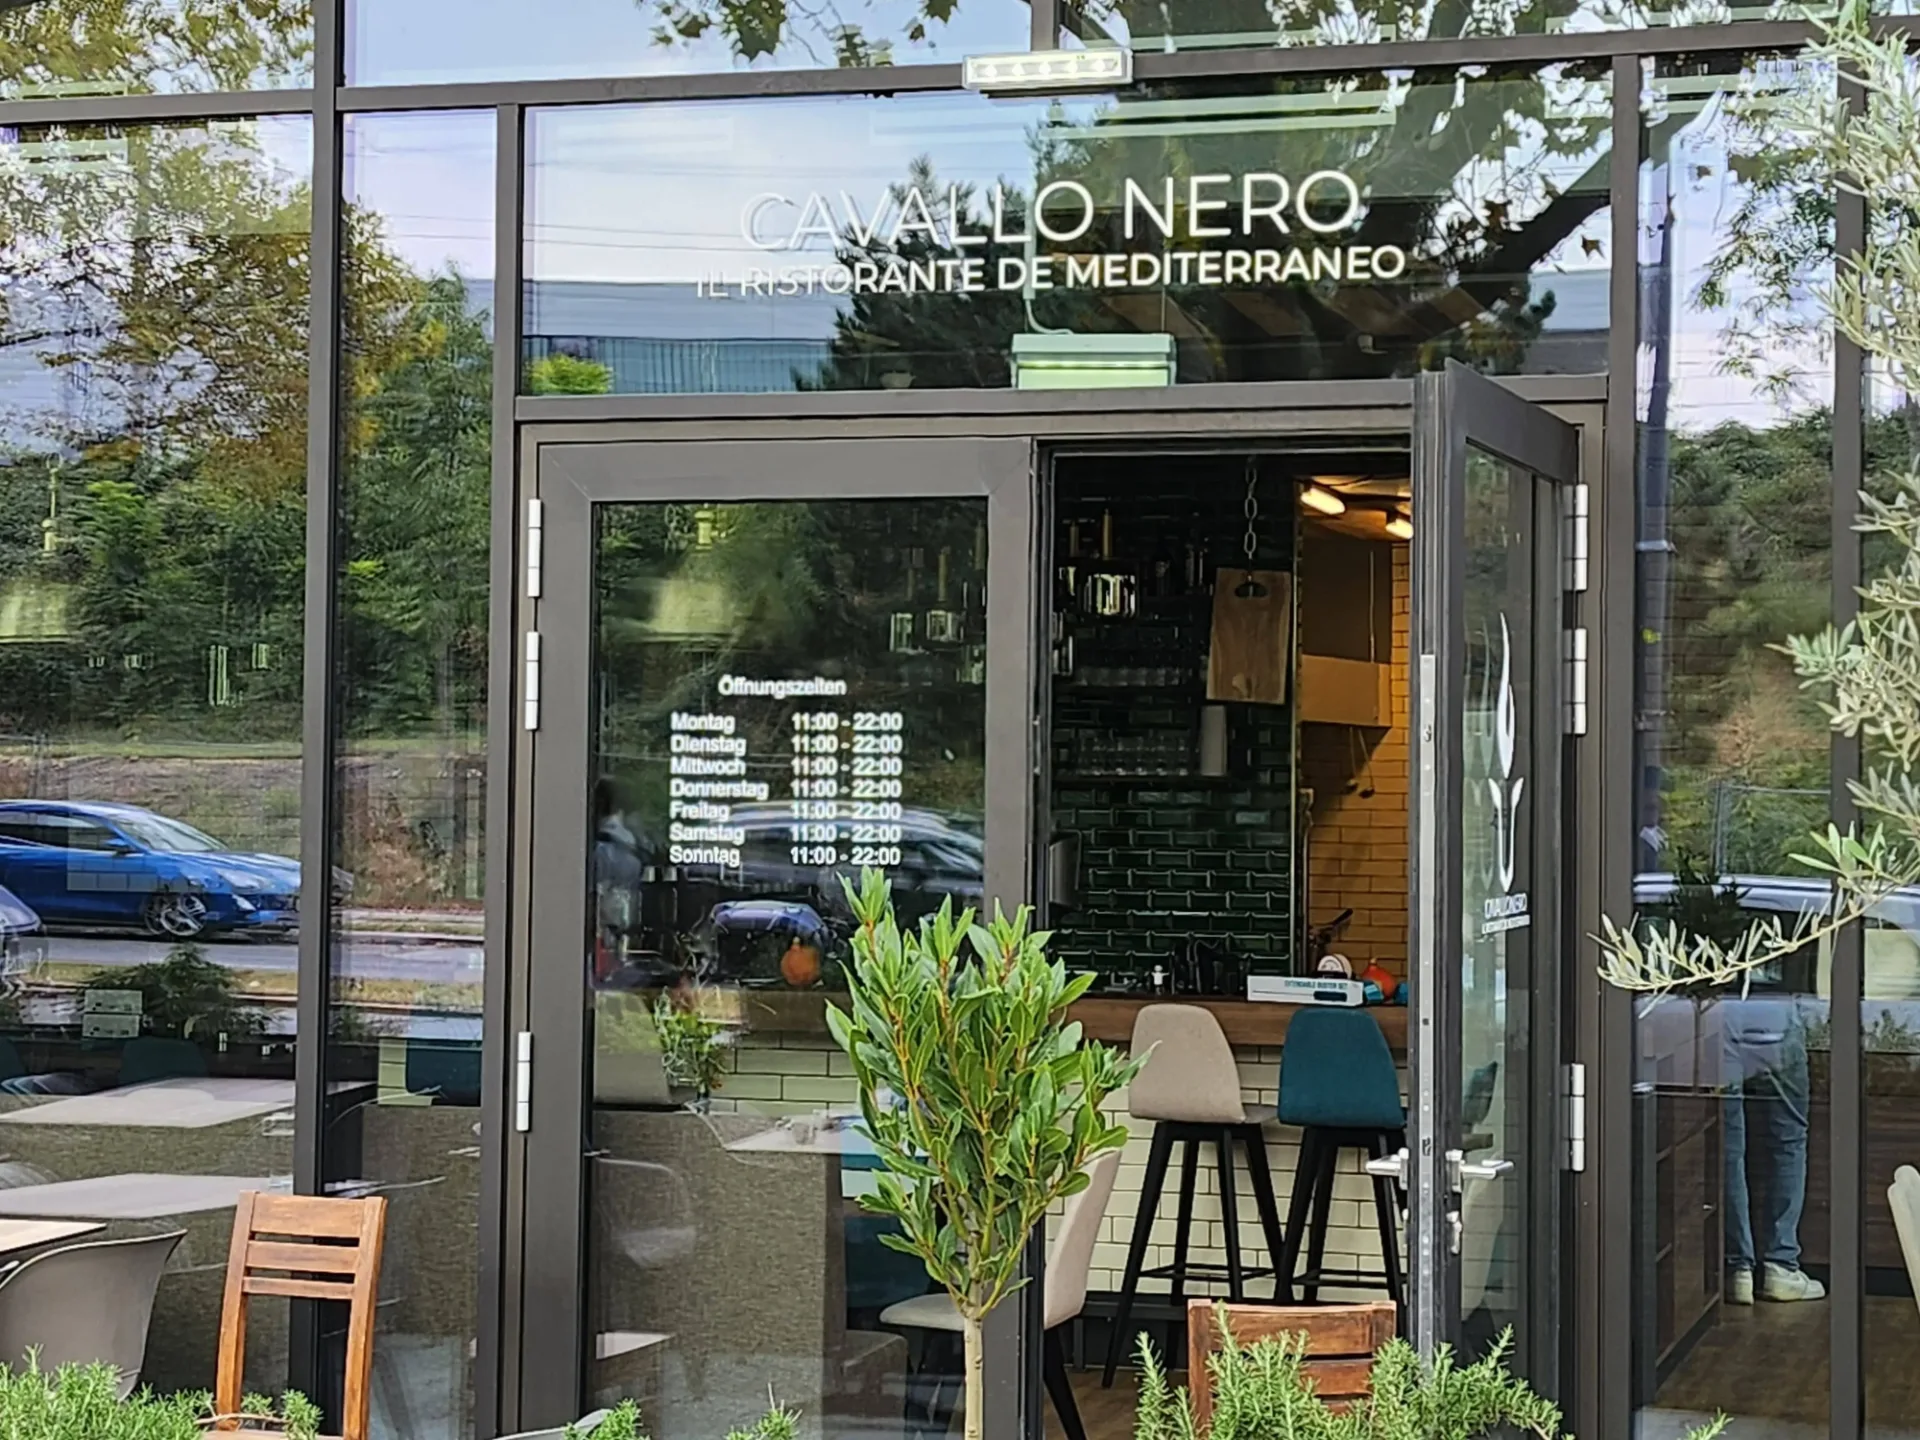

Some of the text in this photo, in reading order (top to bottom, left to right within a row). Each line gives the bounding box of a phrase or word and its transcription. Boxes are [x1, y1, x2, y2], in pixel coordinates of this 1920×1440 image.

[740, 170, 1360, 250] CAVALLO NERO
[696, 245, 1406, 298] IL RISTORANTE DE MEDITERRANEO
[718, 674, 847, 699] Öffnungszeiten
[671, 712, 735, 734] Montag
[791, 712, 839, 731] 11:00
[853, 712, 903, 731] 22:00
[670, 734, 746, 756] Dienstag
[791, 734, 838, 753] 11:00
[852, 734, 903, 753] 22:00
[670, 756, 746, 775] Mittwoch
[791, 756, 838, 776] 11:00
[852, 756, 902, 776] 22:00
[670, 778, 769, 800] Donnerstag
[790, 778, 838, 798] 11:00
[852, 778, 902, 798] 22:00
[669, 800, 730, 822] Freitag
[790, 801, 837, 820] 11:00
[852, 801, 901, 820] 22:00
[669, 822, 745, 845] Samstag
[790, 824, 837, 842] 11:00
[851, 824, 901, 843] 22:00
[669, 845, 740, 867] Sonntag
[791, 846, 837, 865] 11:00
[851, 846, 901, 865] 22:00
